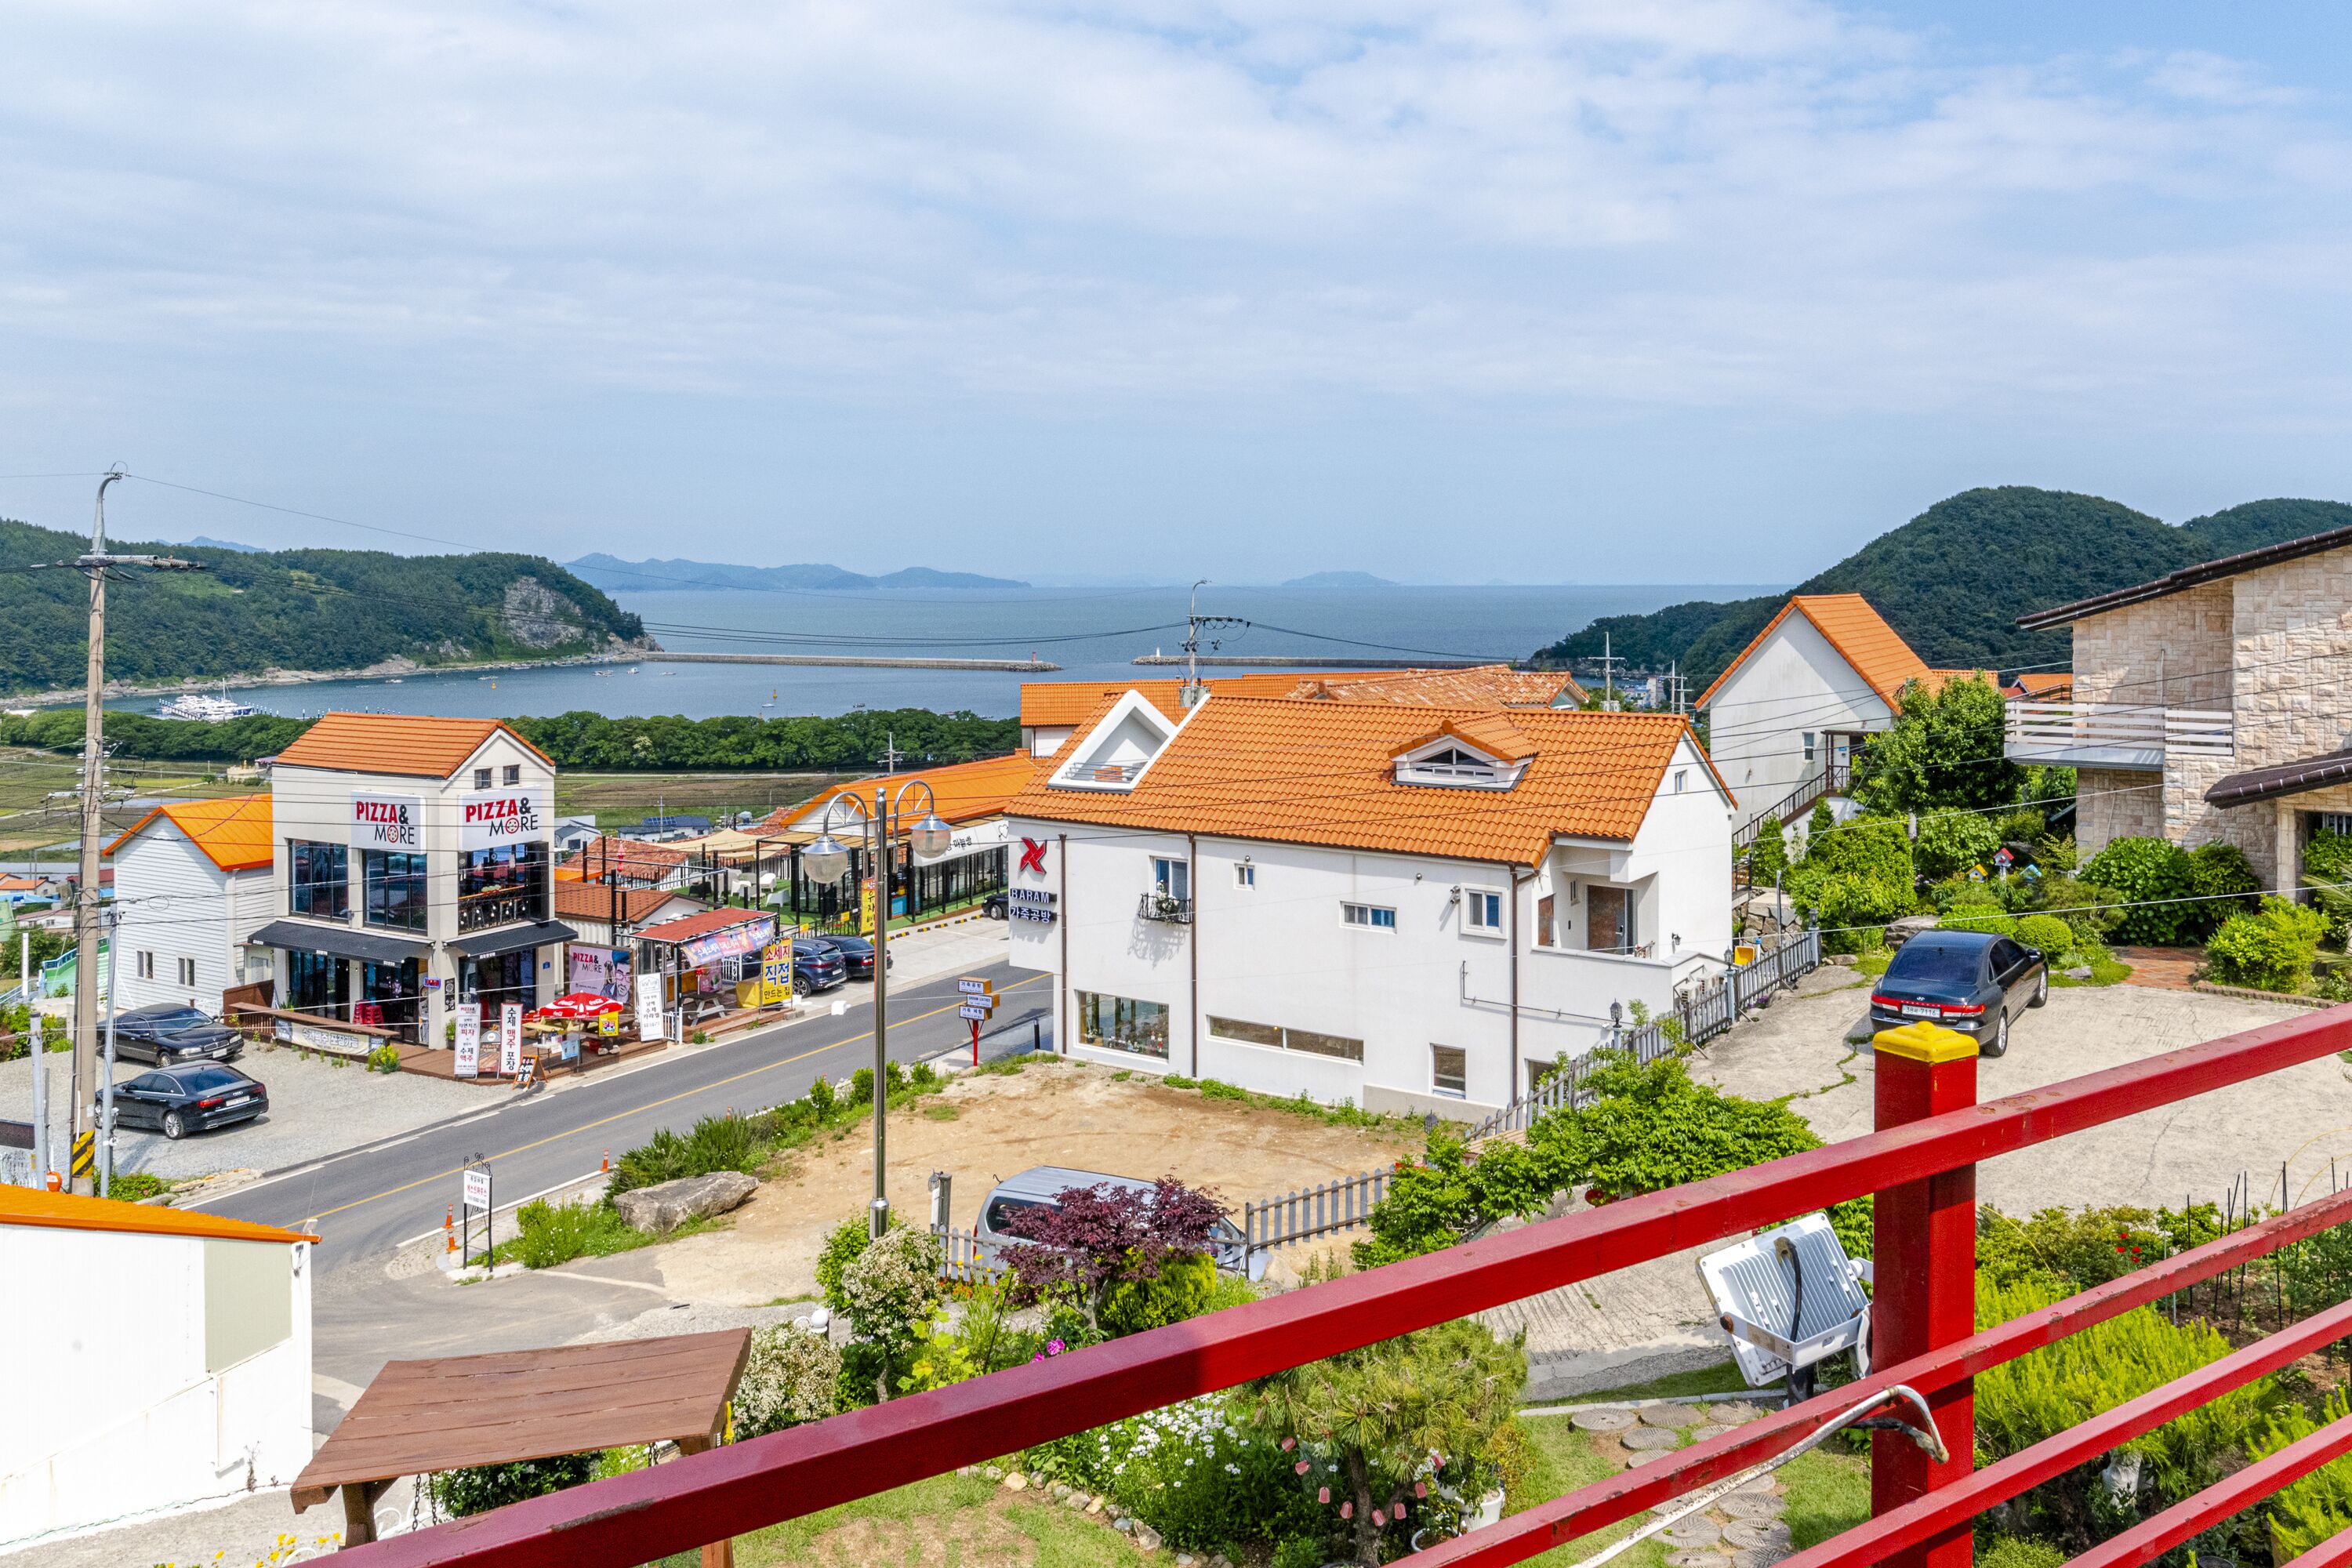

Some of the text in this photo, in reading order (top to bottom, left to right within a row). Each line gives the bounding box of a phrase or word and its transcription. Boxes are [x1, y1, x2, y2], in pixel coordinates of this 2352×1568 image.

[356, 800, 408, 825] PIZZA&
[466, 797, 532, 822] PIZZA&
[374, 823, 415, 845] MORE
[489, 814, 539, 837] MORE
[1011, 888, 1049, 904] BARAM
[1011, 906, 1051, 924] 가죽공방
[573, 953, 598, 964] PIZZA&
[764, 944, 790, 961] 소세지
[582, 964, 602, 973] MORE
[765, 962, 789, 986] 직접
[764, 986, 790, 1000] 만드는 집
[303, 1029, 328, 1044] 수제맥주
[330, 1033, 358, 1048] 포장가능
[506, 1007, 517, 1071] 수제 맥주 포장
